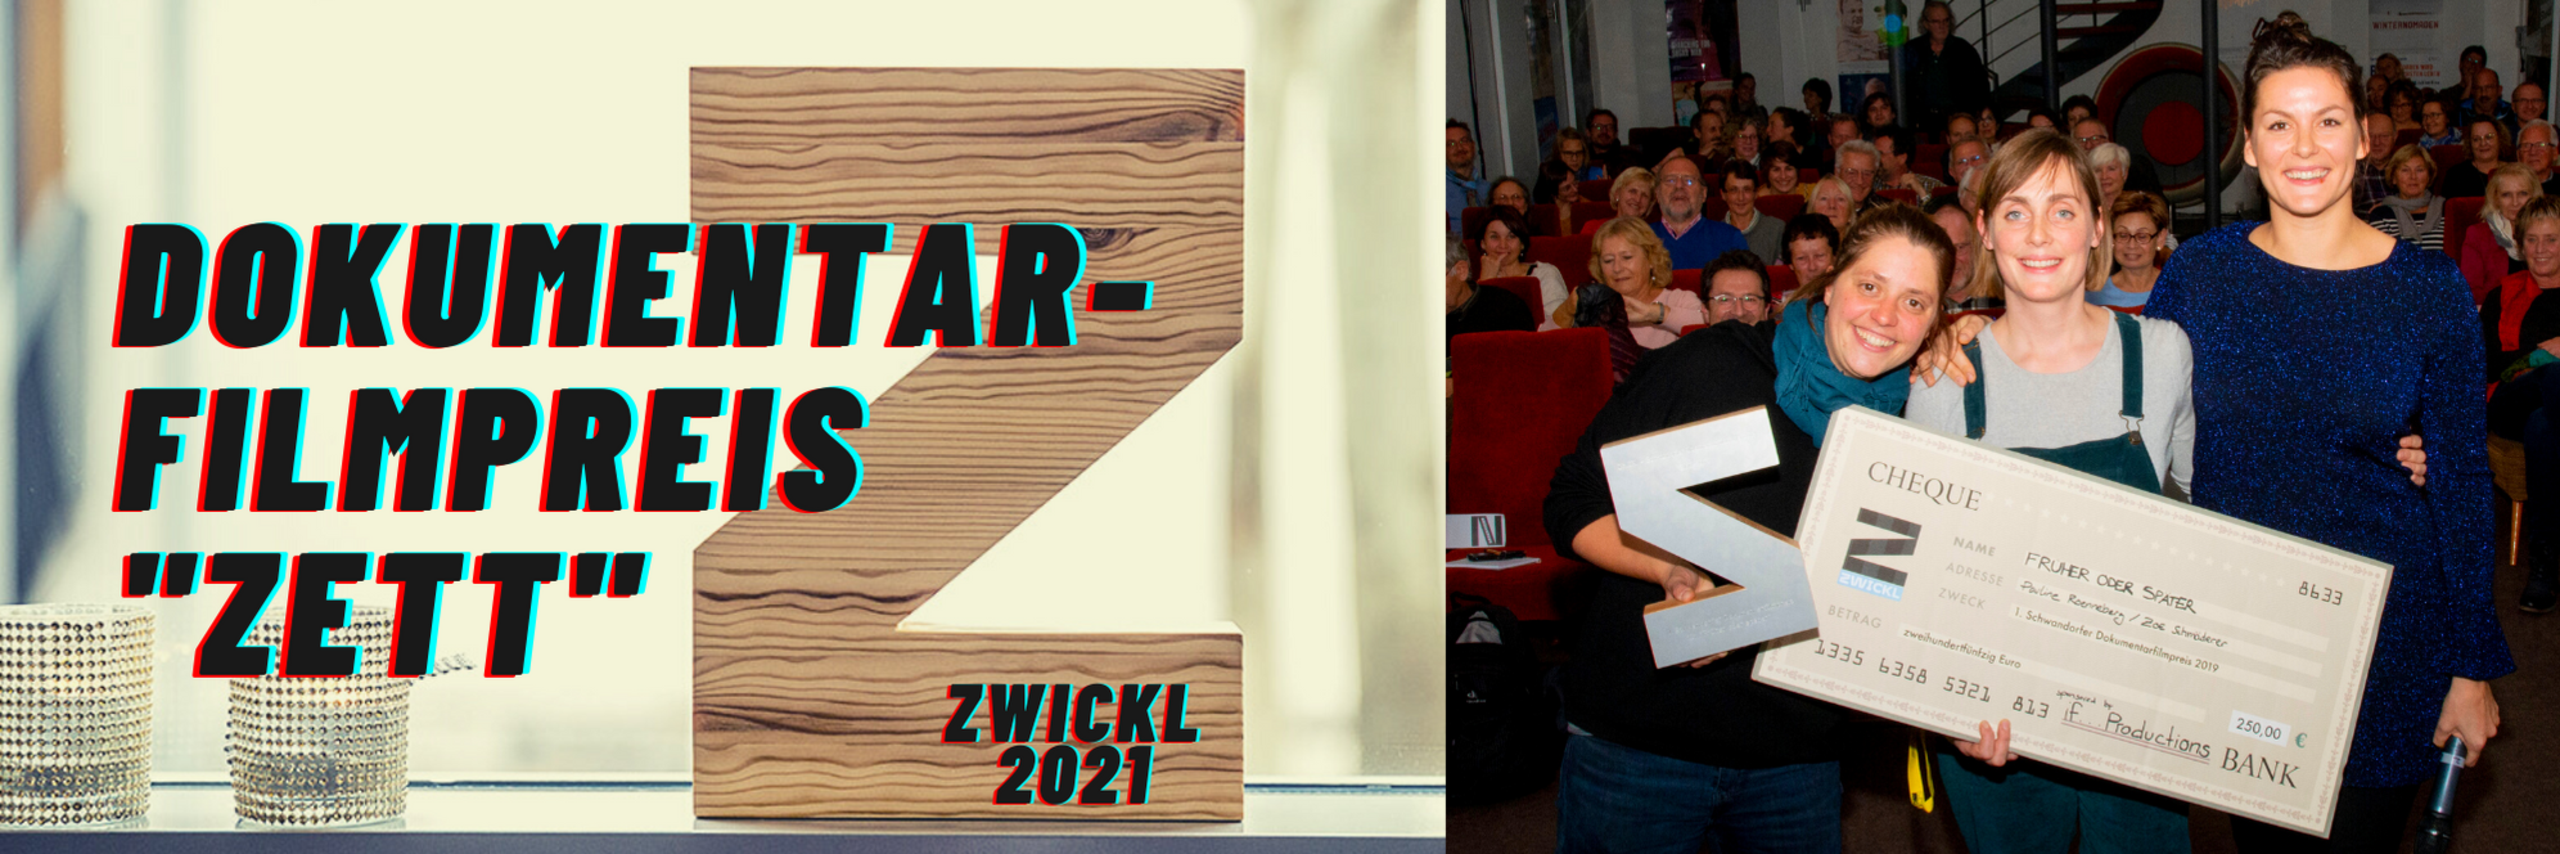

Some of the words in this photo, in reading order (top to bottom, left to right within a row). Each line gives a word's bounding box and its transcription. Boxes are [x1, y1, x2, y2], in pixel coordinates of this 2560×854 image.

[2372, 20, 2439, 30] WINTERNOMADEN
[1868, 461, 1982, 512] CHEQUE
[1953, 536, 1996, 557] NAME
[1838, 571, 1901, 600] ZWICKL
[1945, 562, 2004, 587] ADRESSE
[2096, 574, 2134, 596] ODER
[1938, 587, 1987, 610] ZWECK
[2298, 580, 2343, 606] 8633
[1828, 604, 1882, 629] BETRAG
[1903, 629, 1996, 665] zweihundertfünfzig
[1998, 654, 2022, 669] Euro
[2015, 606, 2023, 618] 1.
[2026, 610, 2093, 637] Schwandorfer
[2095, 630, 2192, 666] Dokumentarfilmpreis
[2194, 659, 2219, 673] 2019
[1815, 638, 1865, 666] 1335
[1879, 657, 1928, 684] 6358
[1943, 676, 1991, 703] 5321
[2012, 696, 2050, 718] 813
[2105, 711, 2211, 759] Productions
[2236, 717, 2282, 741] 250,00
[2221, 746, 2301, 789] BANK
